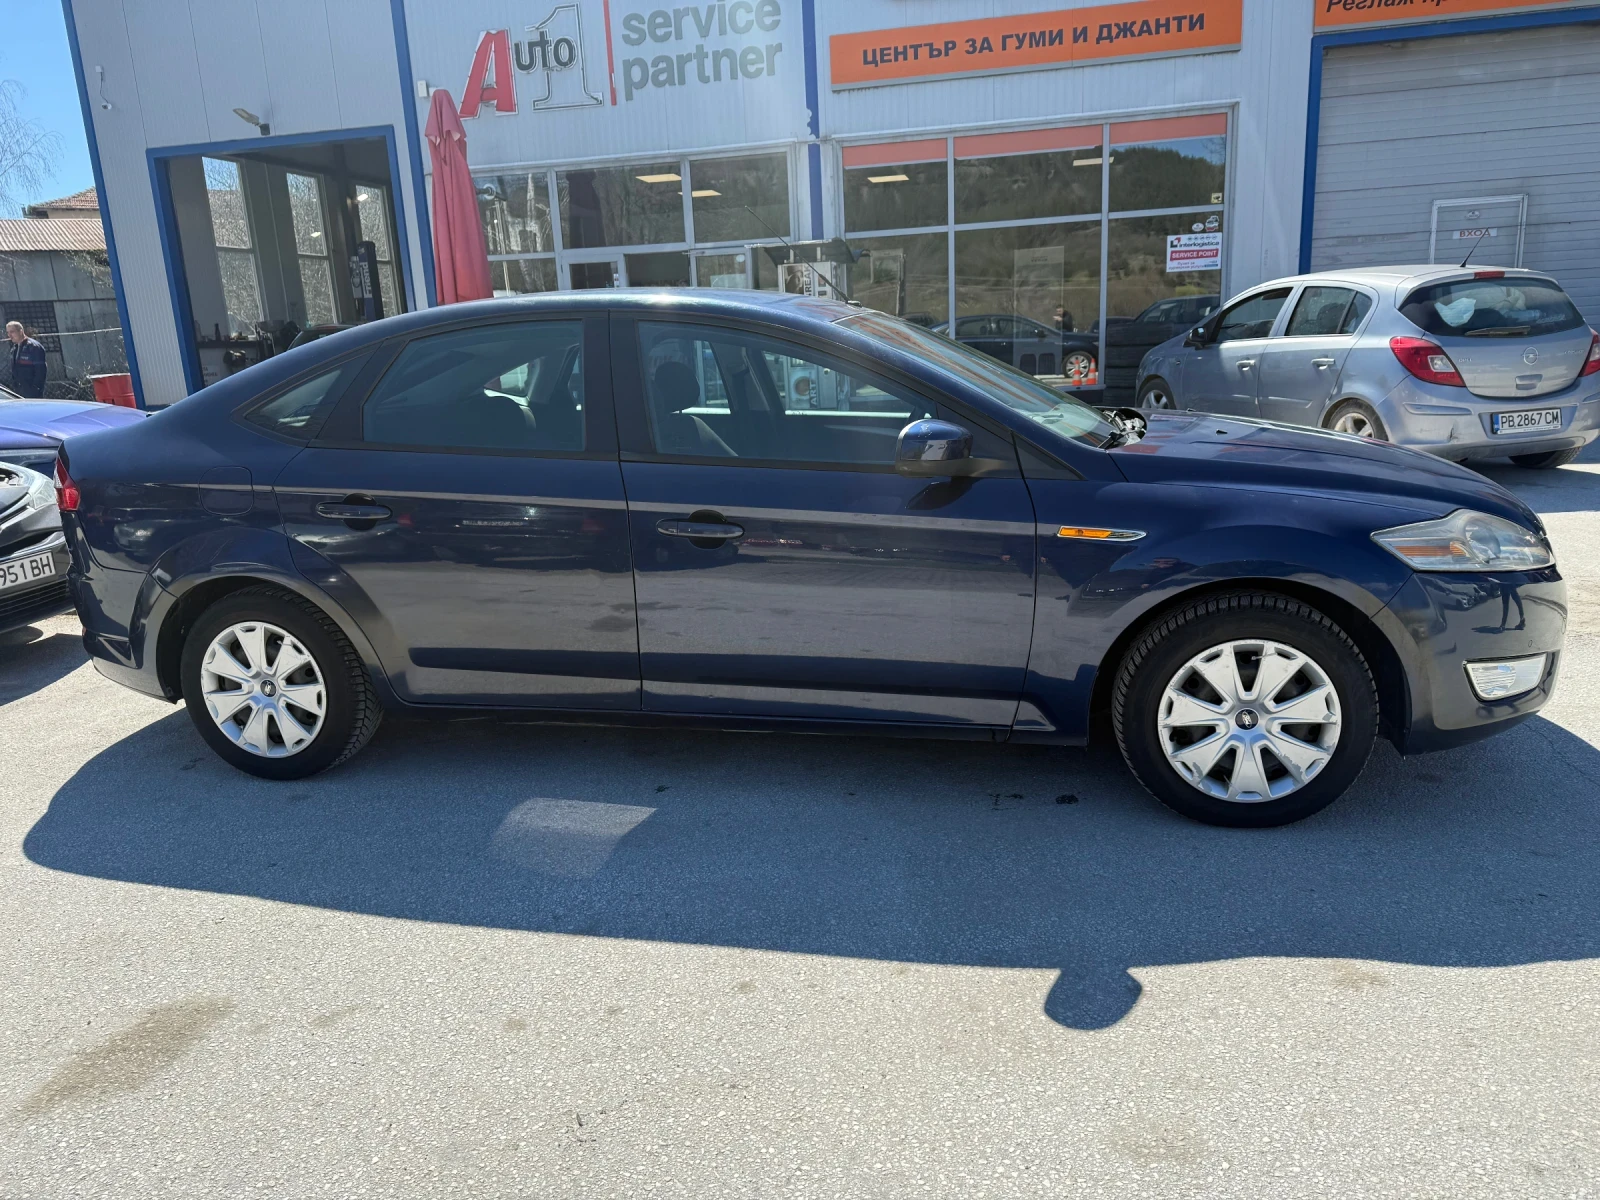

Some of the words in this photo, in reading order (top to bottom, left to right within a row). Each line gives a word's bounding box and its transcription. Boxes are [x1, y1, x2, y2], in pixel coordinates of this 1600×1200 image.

[622, 0, 781, 46] service
[863, 40, 957, 67] ЦЕНТЪР
[965, 37, 994, 55] ЗА
[1001, 29, 1063, 51] ГУМИ
[1072, 26, 1088, 44] И
[1096, 13, 1205, 45] ДЖАНТИ
[623, 43, 782, 101] partner
[1172, 251, 1198, 259] SERVICE
[360, 262, 373, 298] Friend
[803, 265, 812, 296] REAK
[1517, 412, 1543, 427] 2867
[1545, 411, 1560, 425] CM
[29, 555, 53, 578] BH
